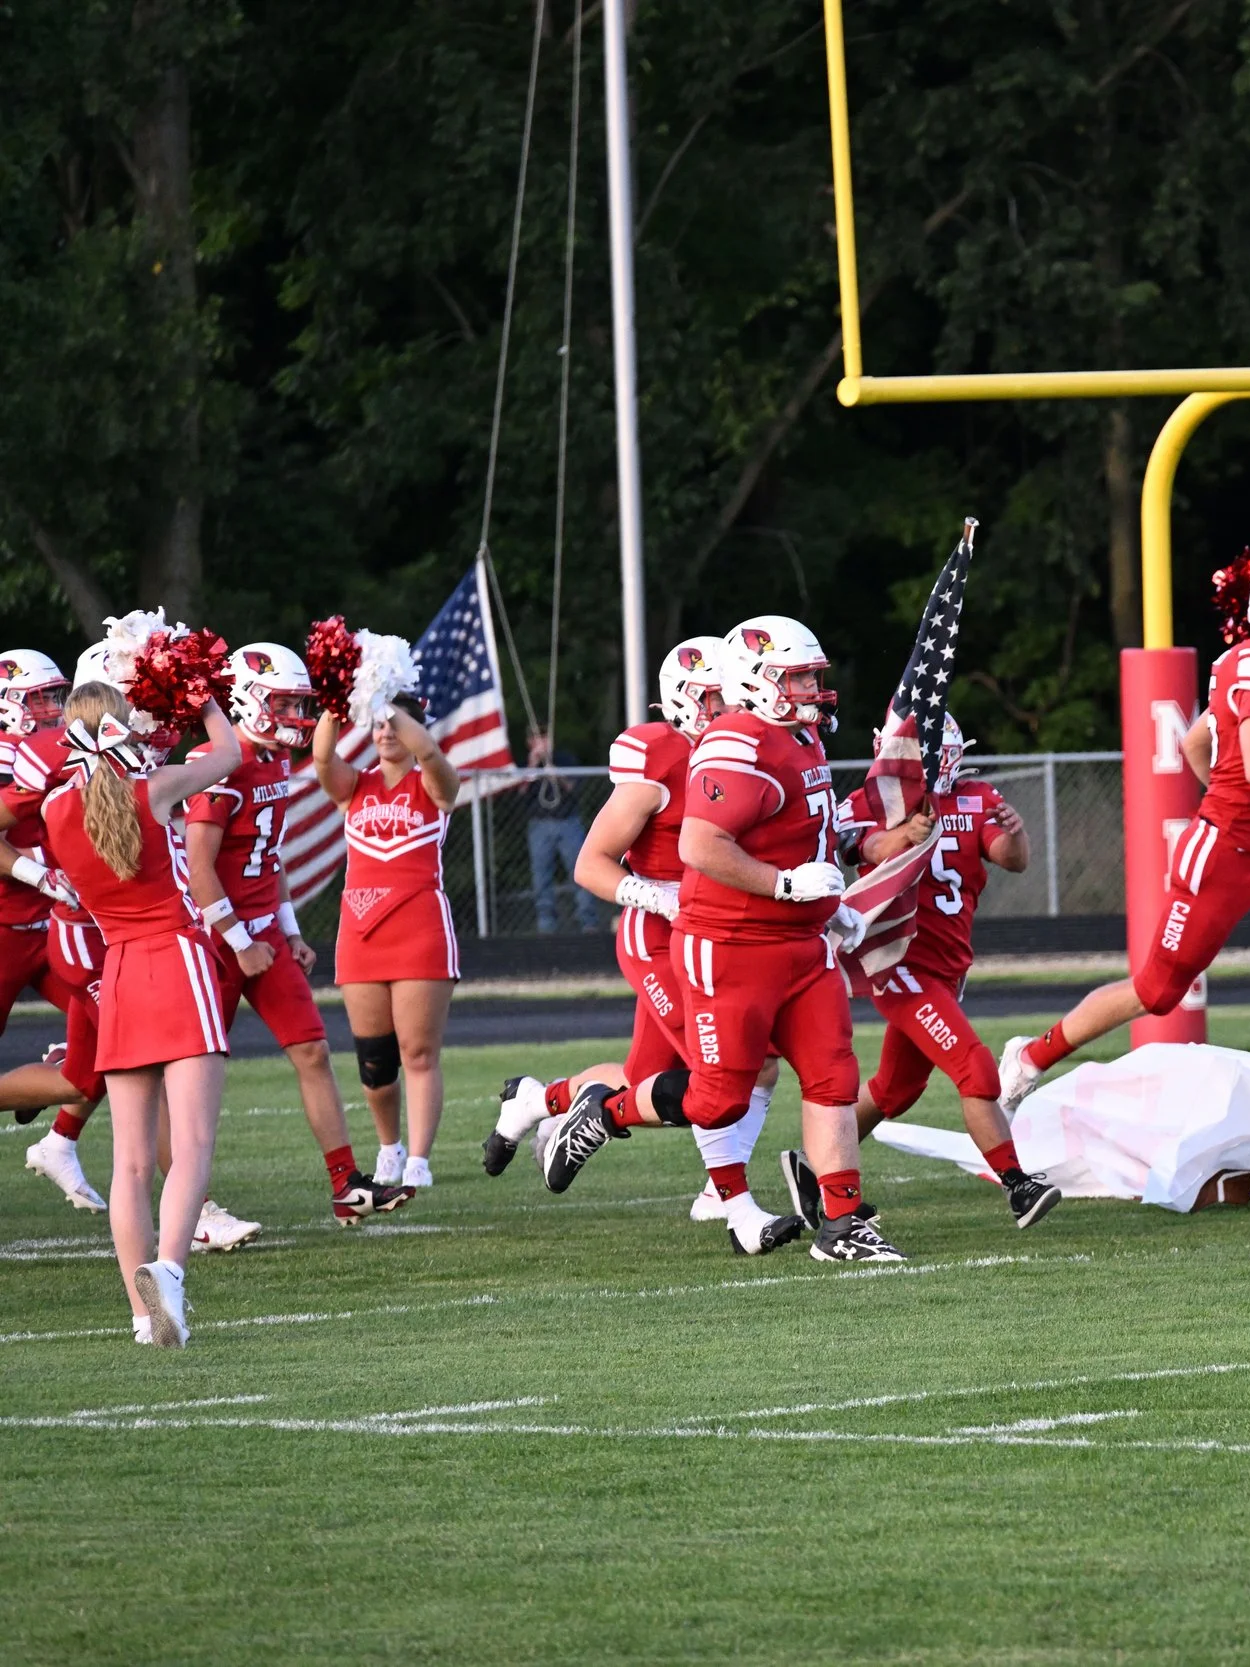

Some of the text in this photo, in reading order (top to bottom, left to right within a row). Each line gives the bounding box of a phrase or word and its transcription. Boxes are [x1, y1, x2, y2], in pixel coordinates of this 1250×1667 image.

[931, 837, 963, 915] 5
[1162, 900, 1191, 952] CARDS
[643, 973, 673, 1017] CARDS
[696, 1013, 720, 1065] CARDS
[915, 1003, 958, 1051] CARDS
